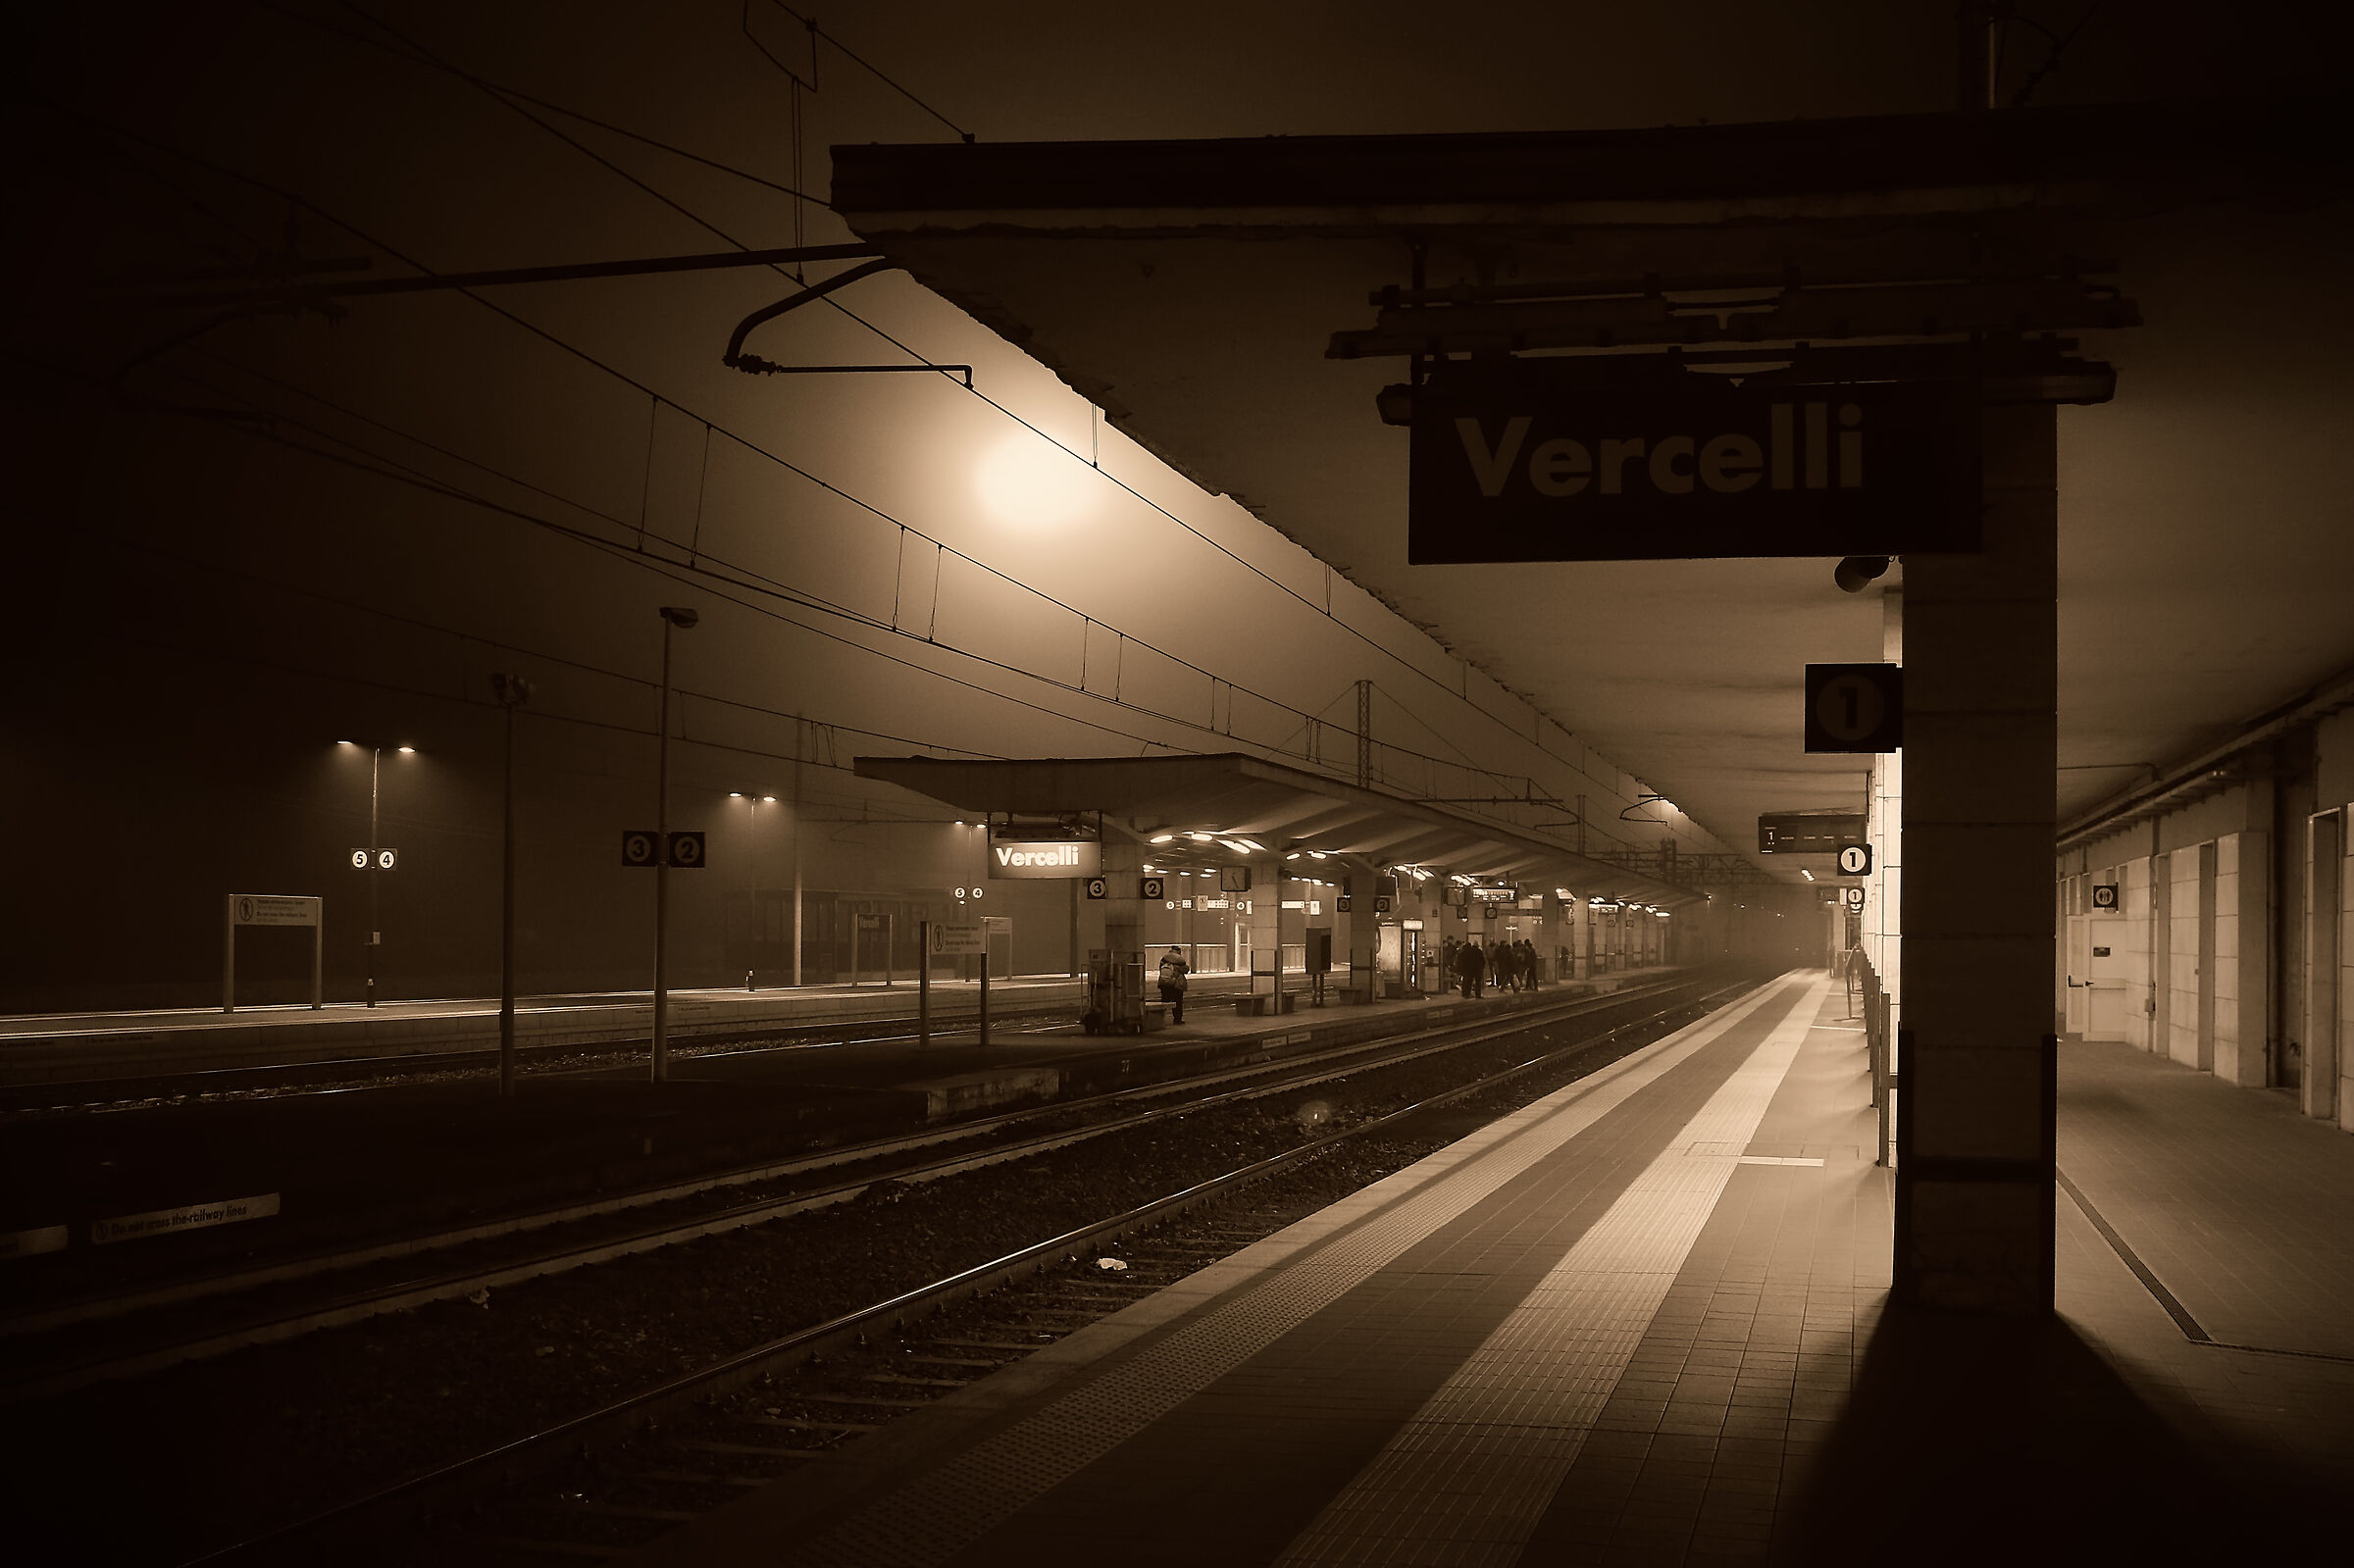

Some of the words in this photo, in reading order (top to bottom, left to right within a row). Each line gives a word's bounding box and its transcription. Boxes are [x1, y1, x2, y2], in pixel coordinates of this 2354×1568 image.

[1453, 400, 1864, 498] Vercelli
[1839, 686, 1858, 729] 1
[633, 839, 643, 857] 3
[682, 841, 693, 859] 2
[357, 854, 364, 864] 5
[384, 855, 390, 865] 4
[996, 845, 1079, 867] Vercelli
[1850, 852, 1856, 867] 1
[1094, 883, 1101, 893] 3
[1149, 883, 1157, 894] 2
[227, 1205, 247, 1218] lines
